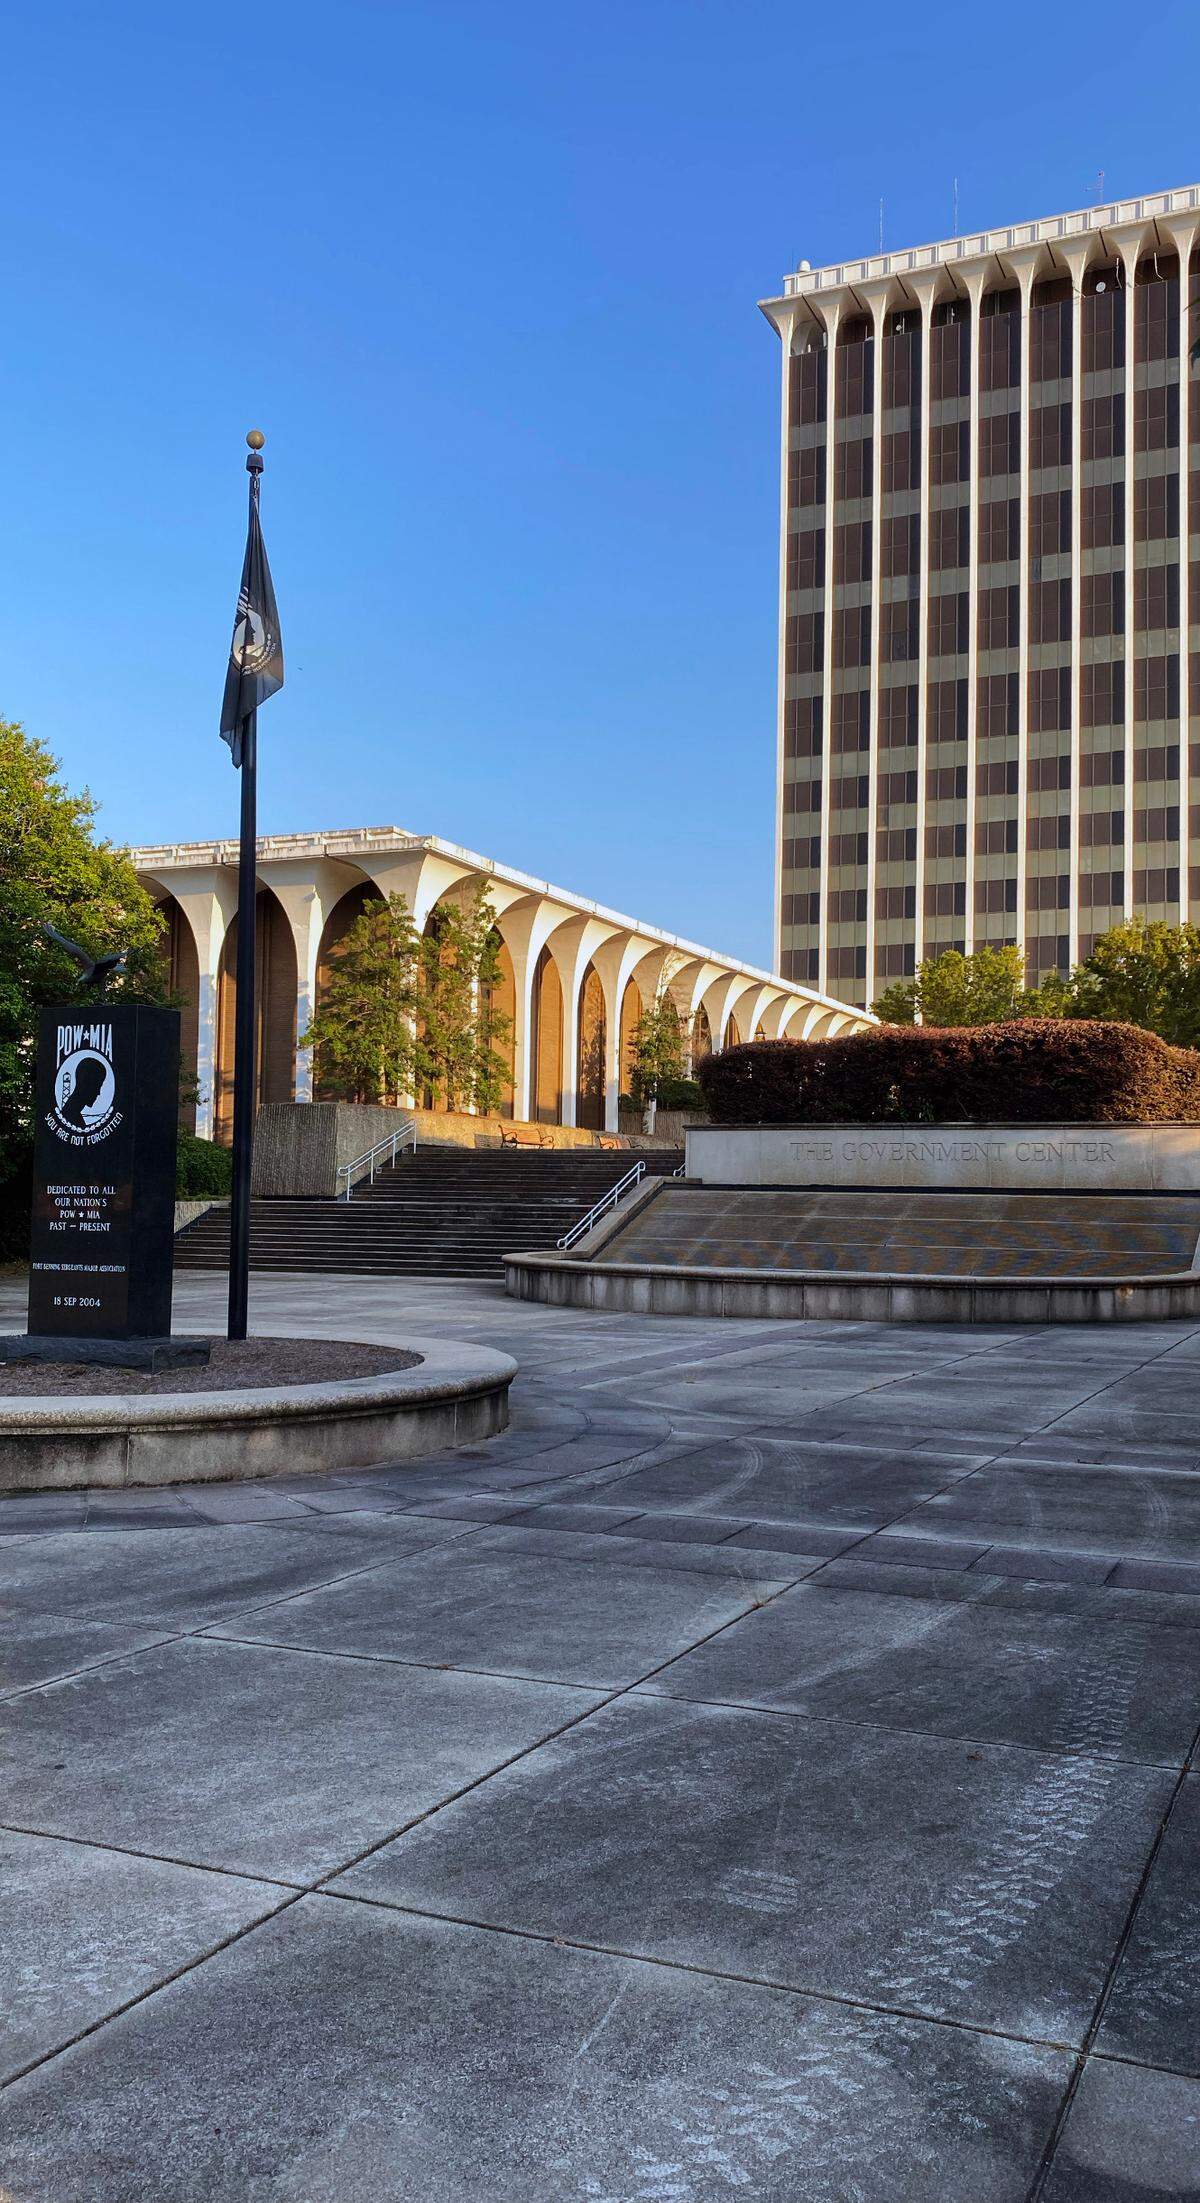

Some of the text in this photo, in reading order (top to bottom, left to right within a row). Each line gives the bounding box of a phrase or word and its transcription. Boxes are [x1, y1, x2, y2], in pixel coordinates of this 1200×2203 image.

[56, 1023, 113, 1070] POW MIA
[44, 1111, 124, 1146] YOU ARE NOT FORGOTTEN
[789, 1142, 1116, 1162] THE GOVERNMENT CENTER
[47, 1185, 116, 1195] DEDICATED TO ALL
[54, 1198, 71, 1207] OUR
[59, 1210, 101, 1219] POW MIA
[49, 1222, 67, 1231] PAST
[79, 1222, 111, 1232] PRESENT
[63, 1296, 77, 1306] SEP
[79, 1297, 101, 1307] 2004
